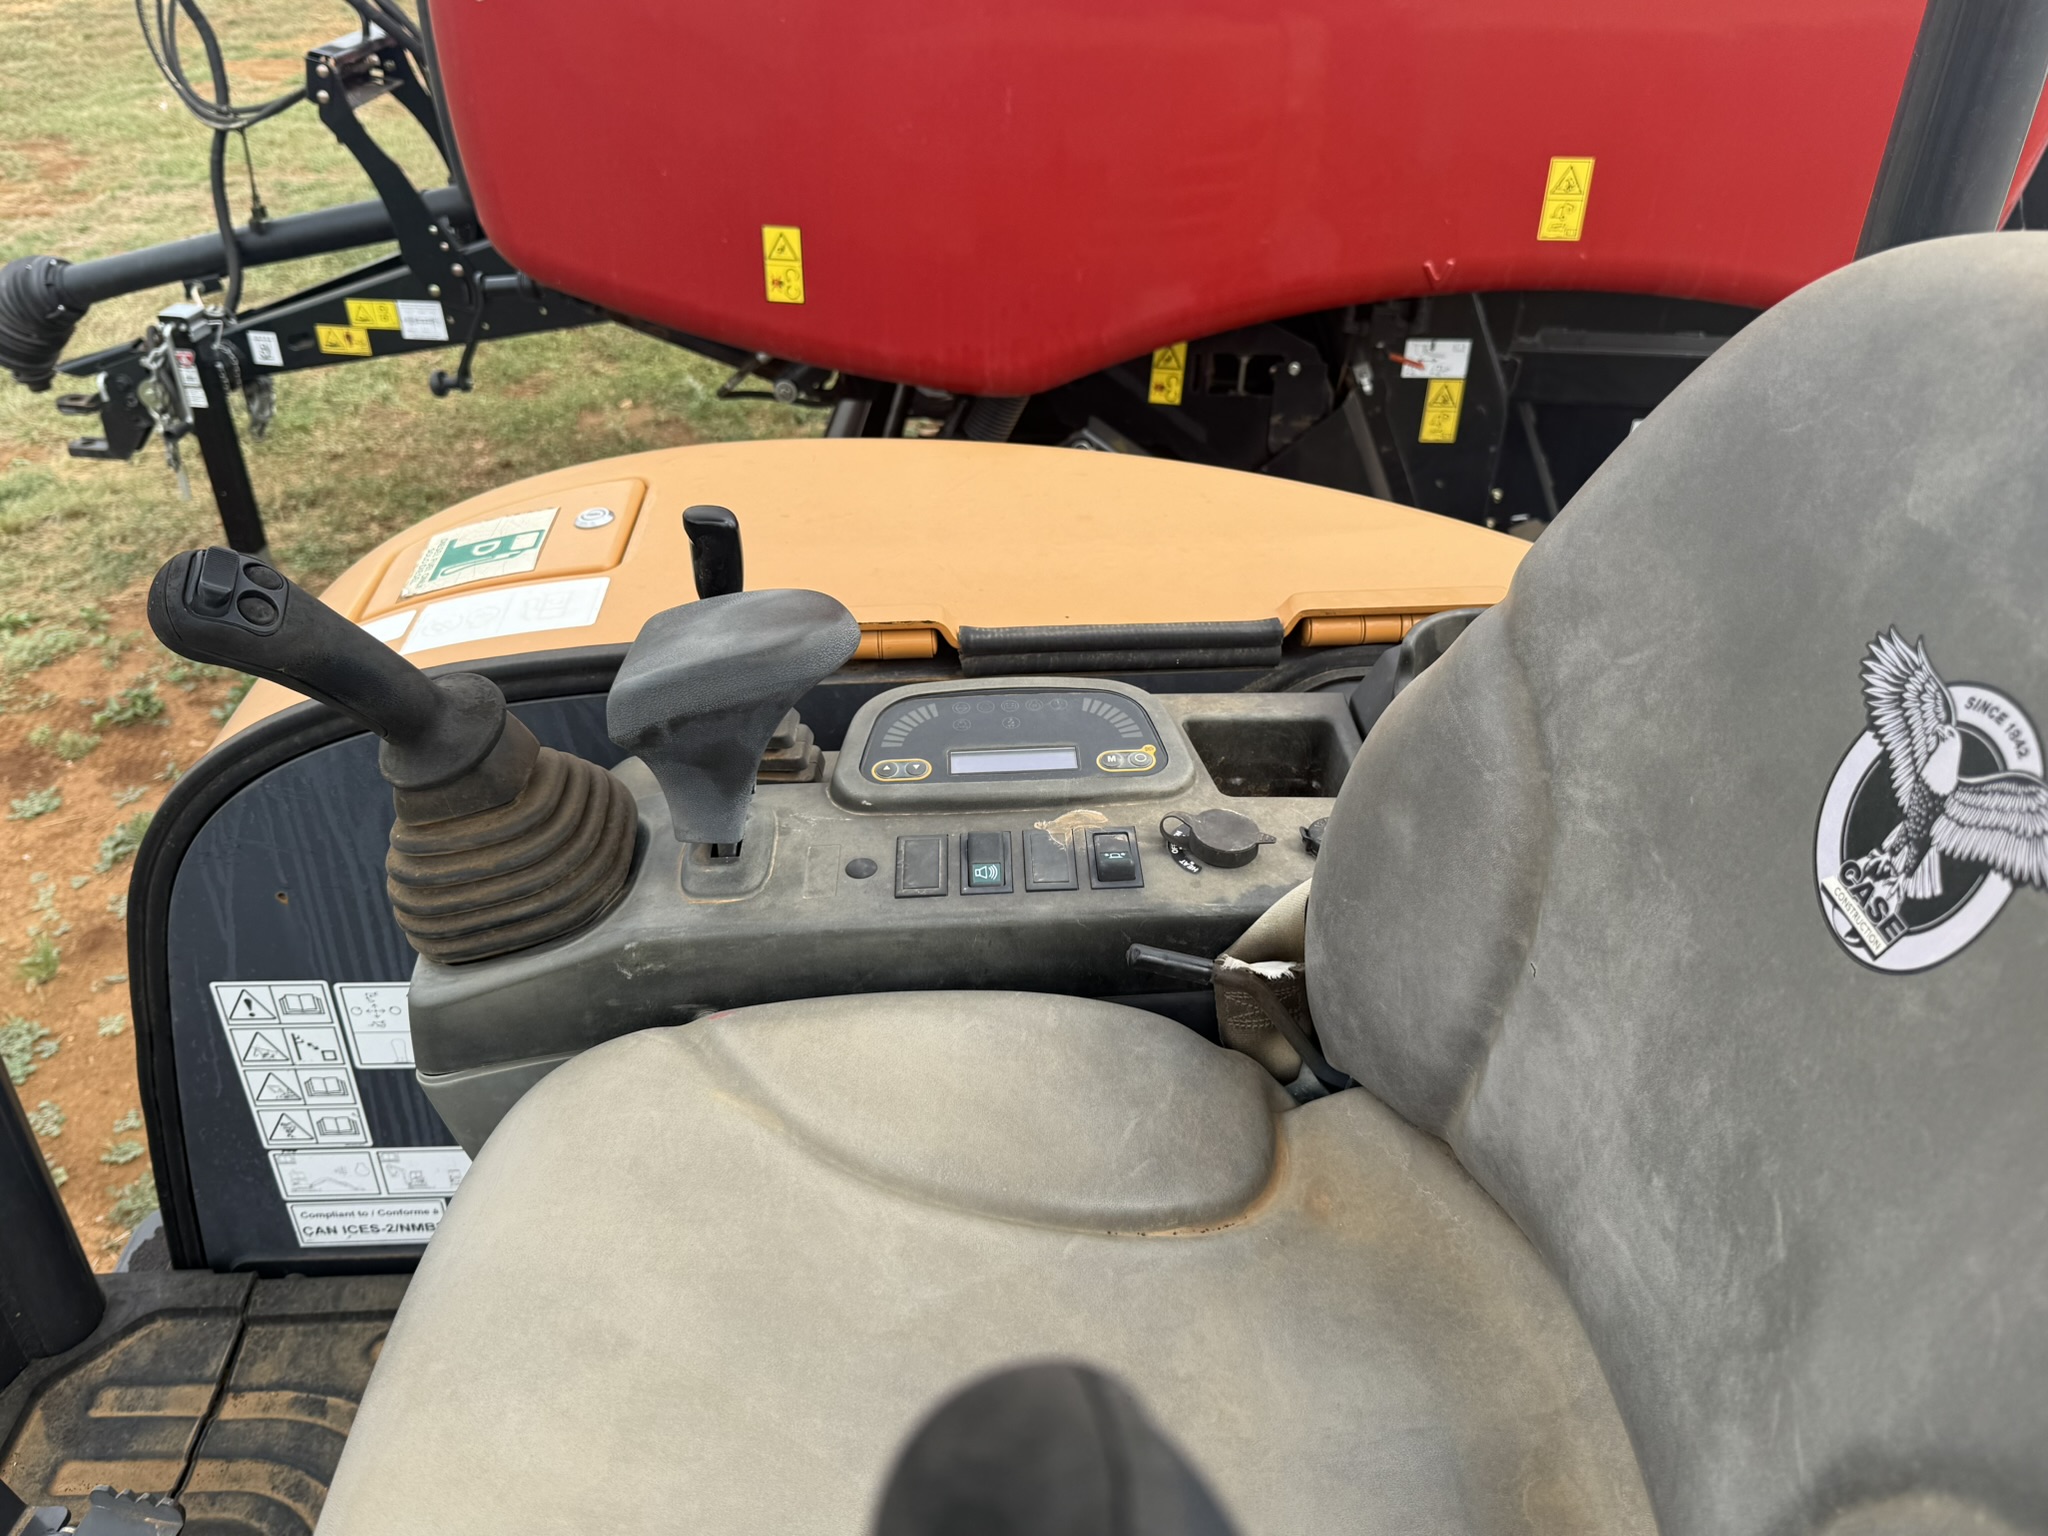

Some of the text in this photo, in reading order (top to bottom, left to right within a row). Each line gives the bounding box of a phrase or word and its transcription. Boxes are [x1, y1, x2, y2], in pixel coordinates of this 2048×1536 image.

[1964, 696, 2030, 760] SINCE 1842
[1179, 860, 1199, 872] HEAT
[1833, 886, 1883, 951] CONSTRUCTION
[1839, 861, 1907, 944] CASE
[300, 1210, 355, 1220] Compliant
[377, 1208, 430, 1216] Conforme
[302, 1222, 438, 1235] CAN ICES-2/NMB
